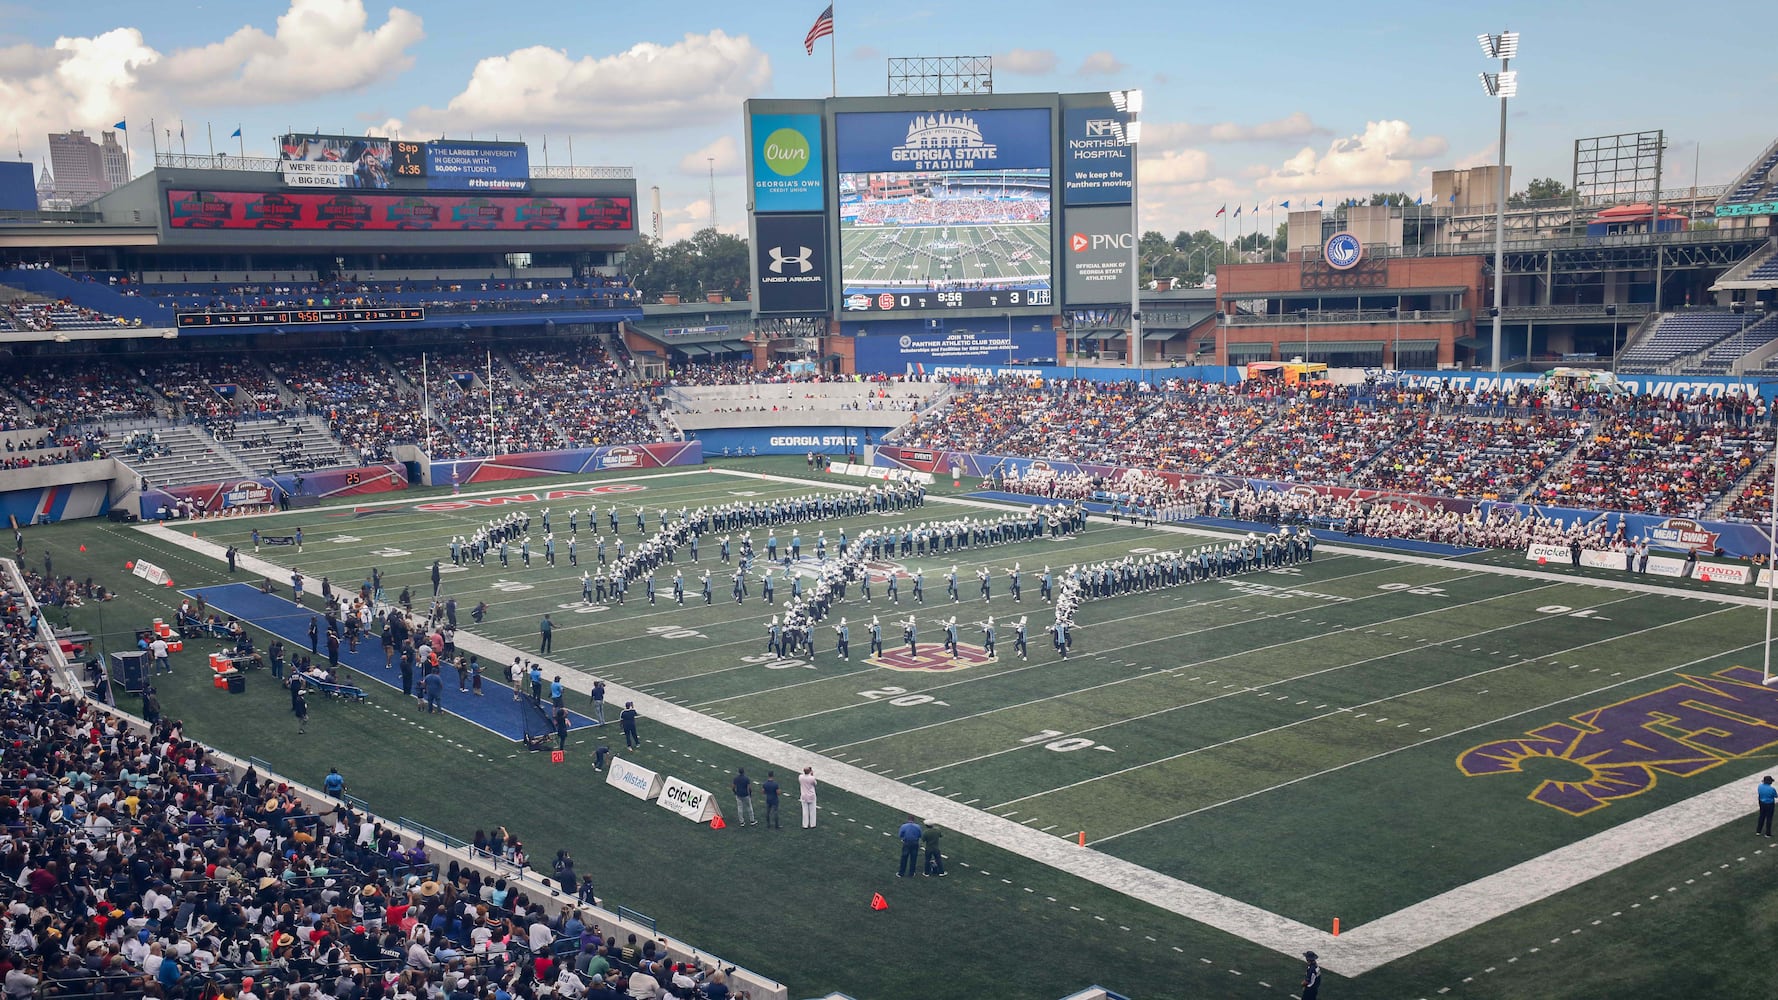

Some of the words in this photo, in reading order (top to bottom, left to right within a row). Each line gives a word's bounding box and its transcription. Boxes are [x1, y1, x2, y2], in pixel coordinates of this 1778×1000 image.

[398, 143, 419, 154] Sep
[766, 143, 806, 160] Own
[891, 149, 952, 161] GEORGIA
[955, 147, 997, 159] STATE
[405, 155, 411, 163] 1
[1074, 150, 1127, 159] HOSPITAL
[288, 163, 316, 171] WE'RE
[317, 164, 338, 173] KIND
[340, 165, 351, 173] OF
[398, 164, 421, 175] 4:35
[915, 160, 974, 170] STADIUM
[1089, 171, 1108, 180] keep
[1110, 170, 1123, 178] the
[469, 179, 526, 189] #thestateway
[756, 180, 799, 188] GEORGIA'S
[1066, 181, 1101, 189] Panthers
[1102, 179, 1132, 188] moving
[1090, 232, 1133, 250] PNC
[901, 295, 911, 307] 0
[937, 292, 963, 302] 9:56
[1010, 292, 1020, 304] 3
[298, 311, 319, 321] 9:56
[989, 338, 1010, 346] TODAY!
[1645, 381, 1760, 400] VICTORY
[770, 436, 820, 446] GEORGIA
[822, 436, 858, 446] STATE
[602, 455, 619, 464] MEAC
[621, 454, 638, 463] SWAC
[914, 452, 932, 460] EVENTS
[346, 473, 361, 485] 25
[228, 490, 247, 501] MEAC
[249, 489, 268, 499] SWAC
[415, 484, 646, 511] SWAC
[1653, 528, 1678, 541] MEAC
[1681, 532, 1709, 544] SWAC
[1534, 546, 1569, 558] cricket
[1697, 565, 1743, 577] HONDA
[857, 686, 935, 707] 20
[1020, 729, 1096, 752] 10
[552, 752, 563, 762] 20
[622, 771, 648, 791] Allstate
[667, 785, 703, 810] cricket
